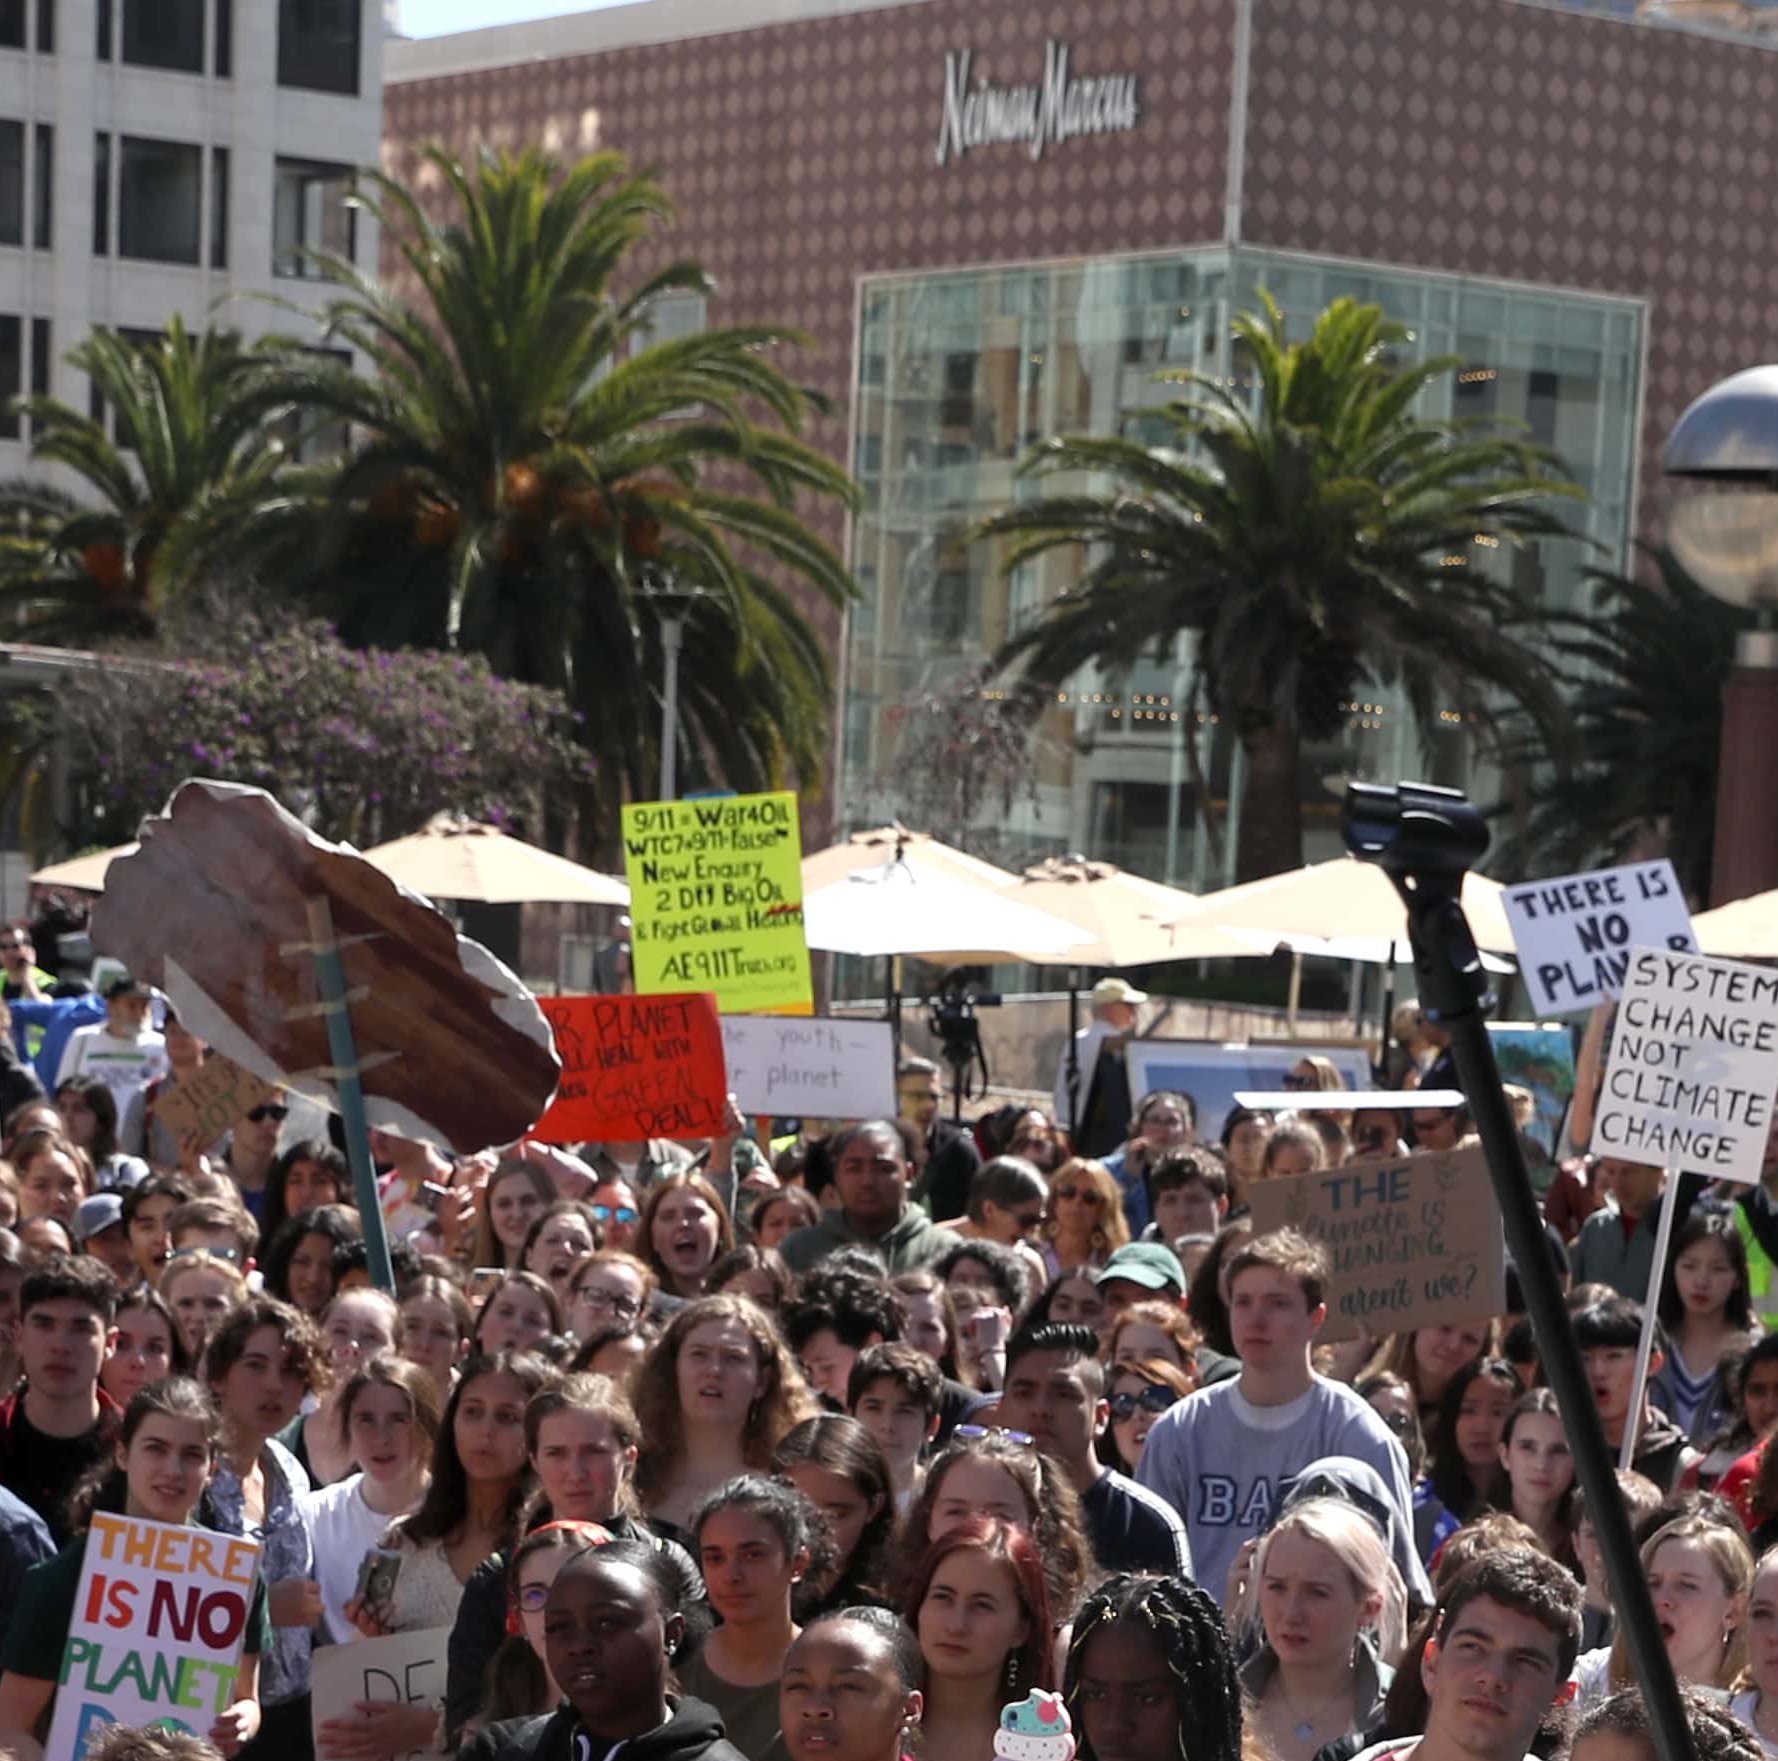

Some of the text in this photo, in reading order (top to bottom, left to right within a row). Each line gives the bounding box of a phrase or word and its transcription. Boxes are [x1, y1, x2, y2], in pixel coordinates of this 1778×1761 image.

[1513, 869, 1669, 919] THERE IS
[1576, 913, 1630, 954] NO
[776, 1026, 841, 1052] youth
[1618, 1034, 1690, 1068] NOT
[1624, 997, 1778, 1053] CHANGE
[767, 1063, 844, 1095] planet
[1610, 1069, 1766, 1129] CLIMATE
[1600, 1111, 1737, 1164] CHANGE
[1321, 1166, 1411, 1212] THE
[1198, 1474, 1284, 1527] BA
[93, 1518, 261, 1584] THERE
[84, 1572, 246, 1649] IS NO
[59, 1636, 241, 1714] PLANET
